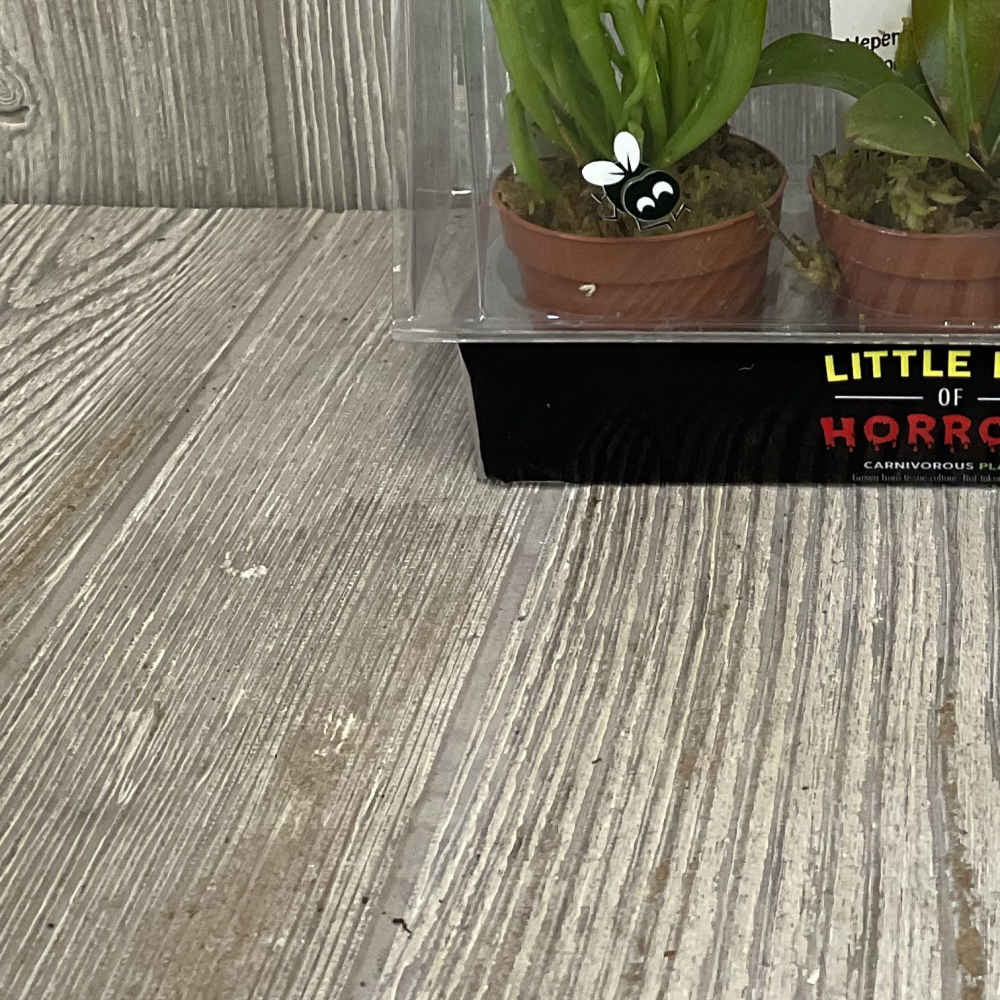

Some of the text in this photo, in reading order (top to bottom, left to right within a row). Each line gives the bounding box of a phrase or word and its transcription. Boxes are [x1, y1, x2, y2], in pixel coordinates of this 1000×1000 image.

[824, 349, 972, 383] LITTLE
[937, 387, 964, 407] OF
[863, 460, 975, 471] CARNIVOROUS
